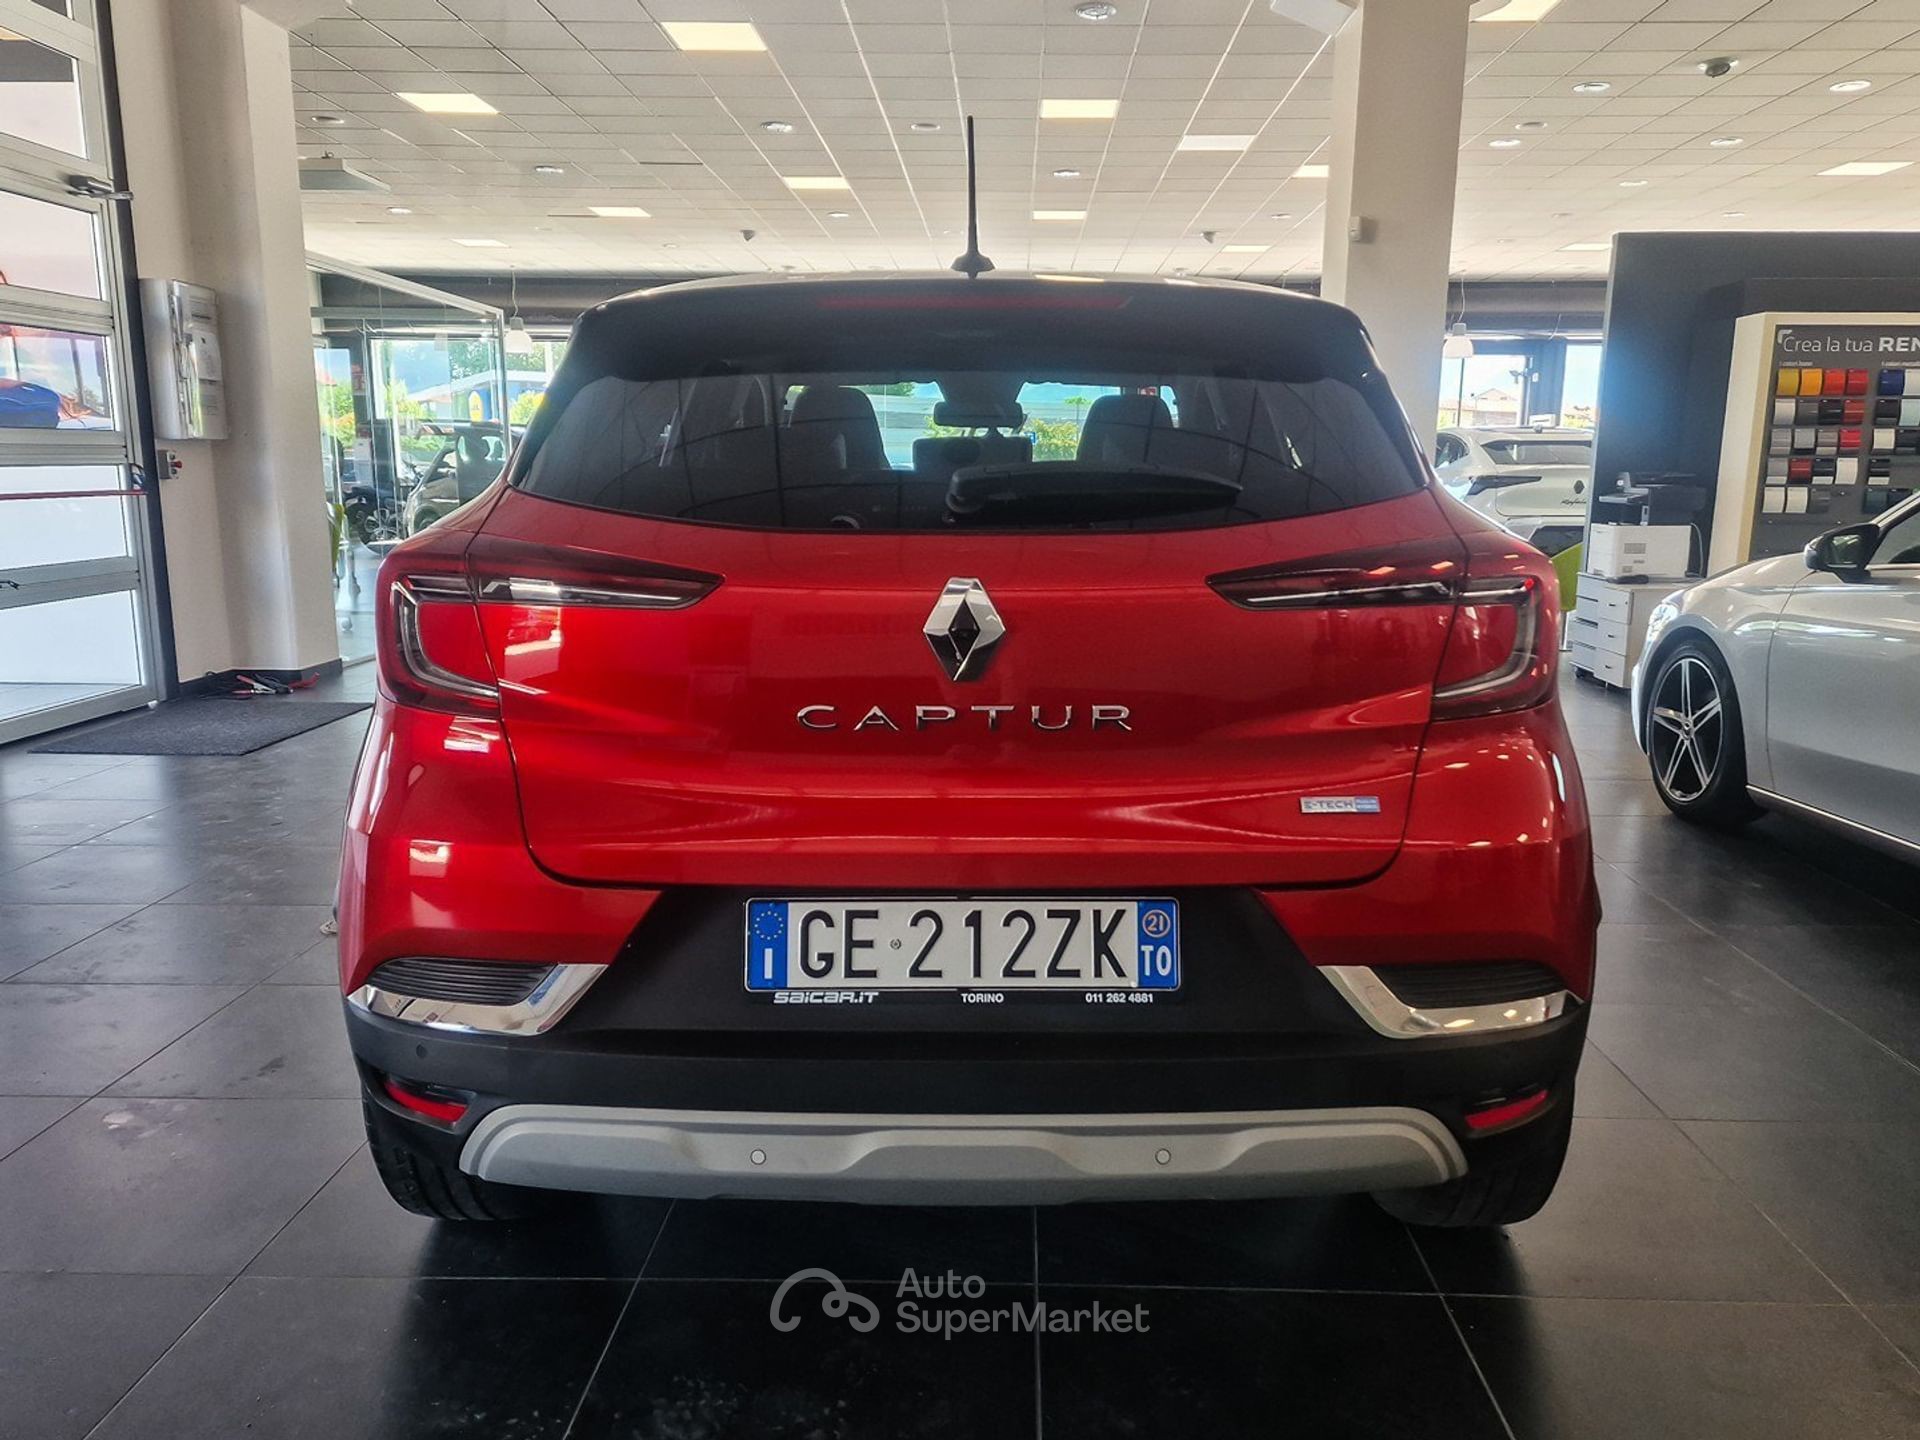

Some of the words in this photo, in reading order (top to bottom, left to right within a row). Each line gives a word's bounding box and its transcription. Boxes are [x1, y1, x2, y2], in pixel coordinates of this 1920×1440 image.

[1783, 336, 1822, 352] Crea
[1826, 336, 1840, 352] la
[1845, 337, 1873, 352] tua
[796, 704, 1133, 732] CAPTUR
[1303, 799, 1354, 809] E-TECH
[1147, 914, 1164, 931] 21
[798, 909, 879, 979] GE
[908, 909, 1128, 979] 212ZK
[1140, 945, 1172, 976] TO
[961, 993, 1004, 1003] TORINO
[1085, 993, 1103, 1003] 011
[1105, 993, 1126, 1003] 262
[1127, 993, 1154, 1003] 4881
